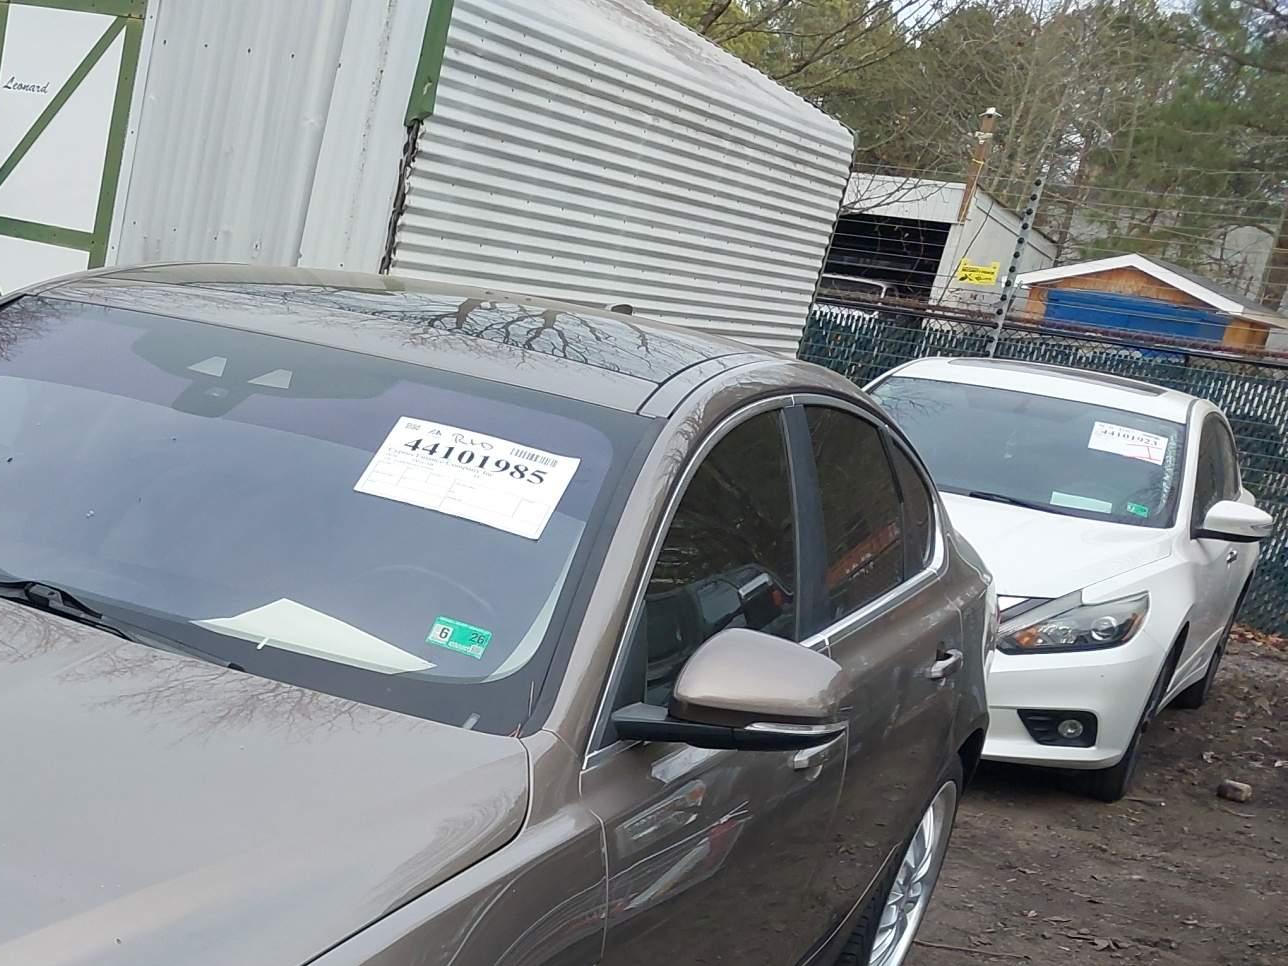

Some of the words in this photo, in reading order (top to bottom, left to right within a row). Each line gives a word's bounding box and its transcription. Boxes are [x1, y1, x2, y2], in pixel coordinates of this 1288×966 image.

[3, 76, 50, 94] Leonard
[404, 438, 548, 486] 44101985
[439, 627, 450, 639] 6
[469, 632, 486, 645] 26
